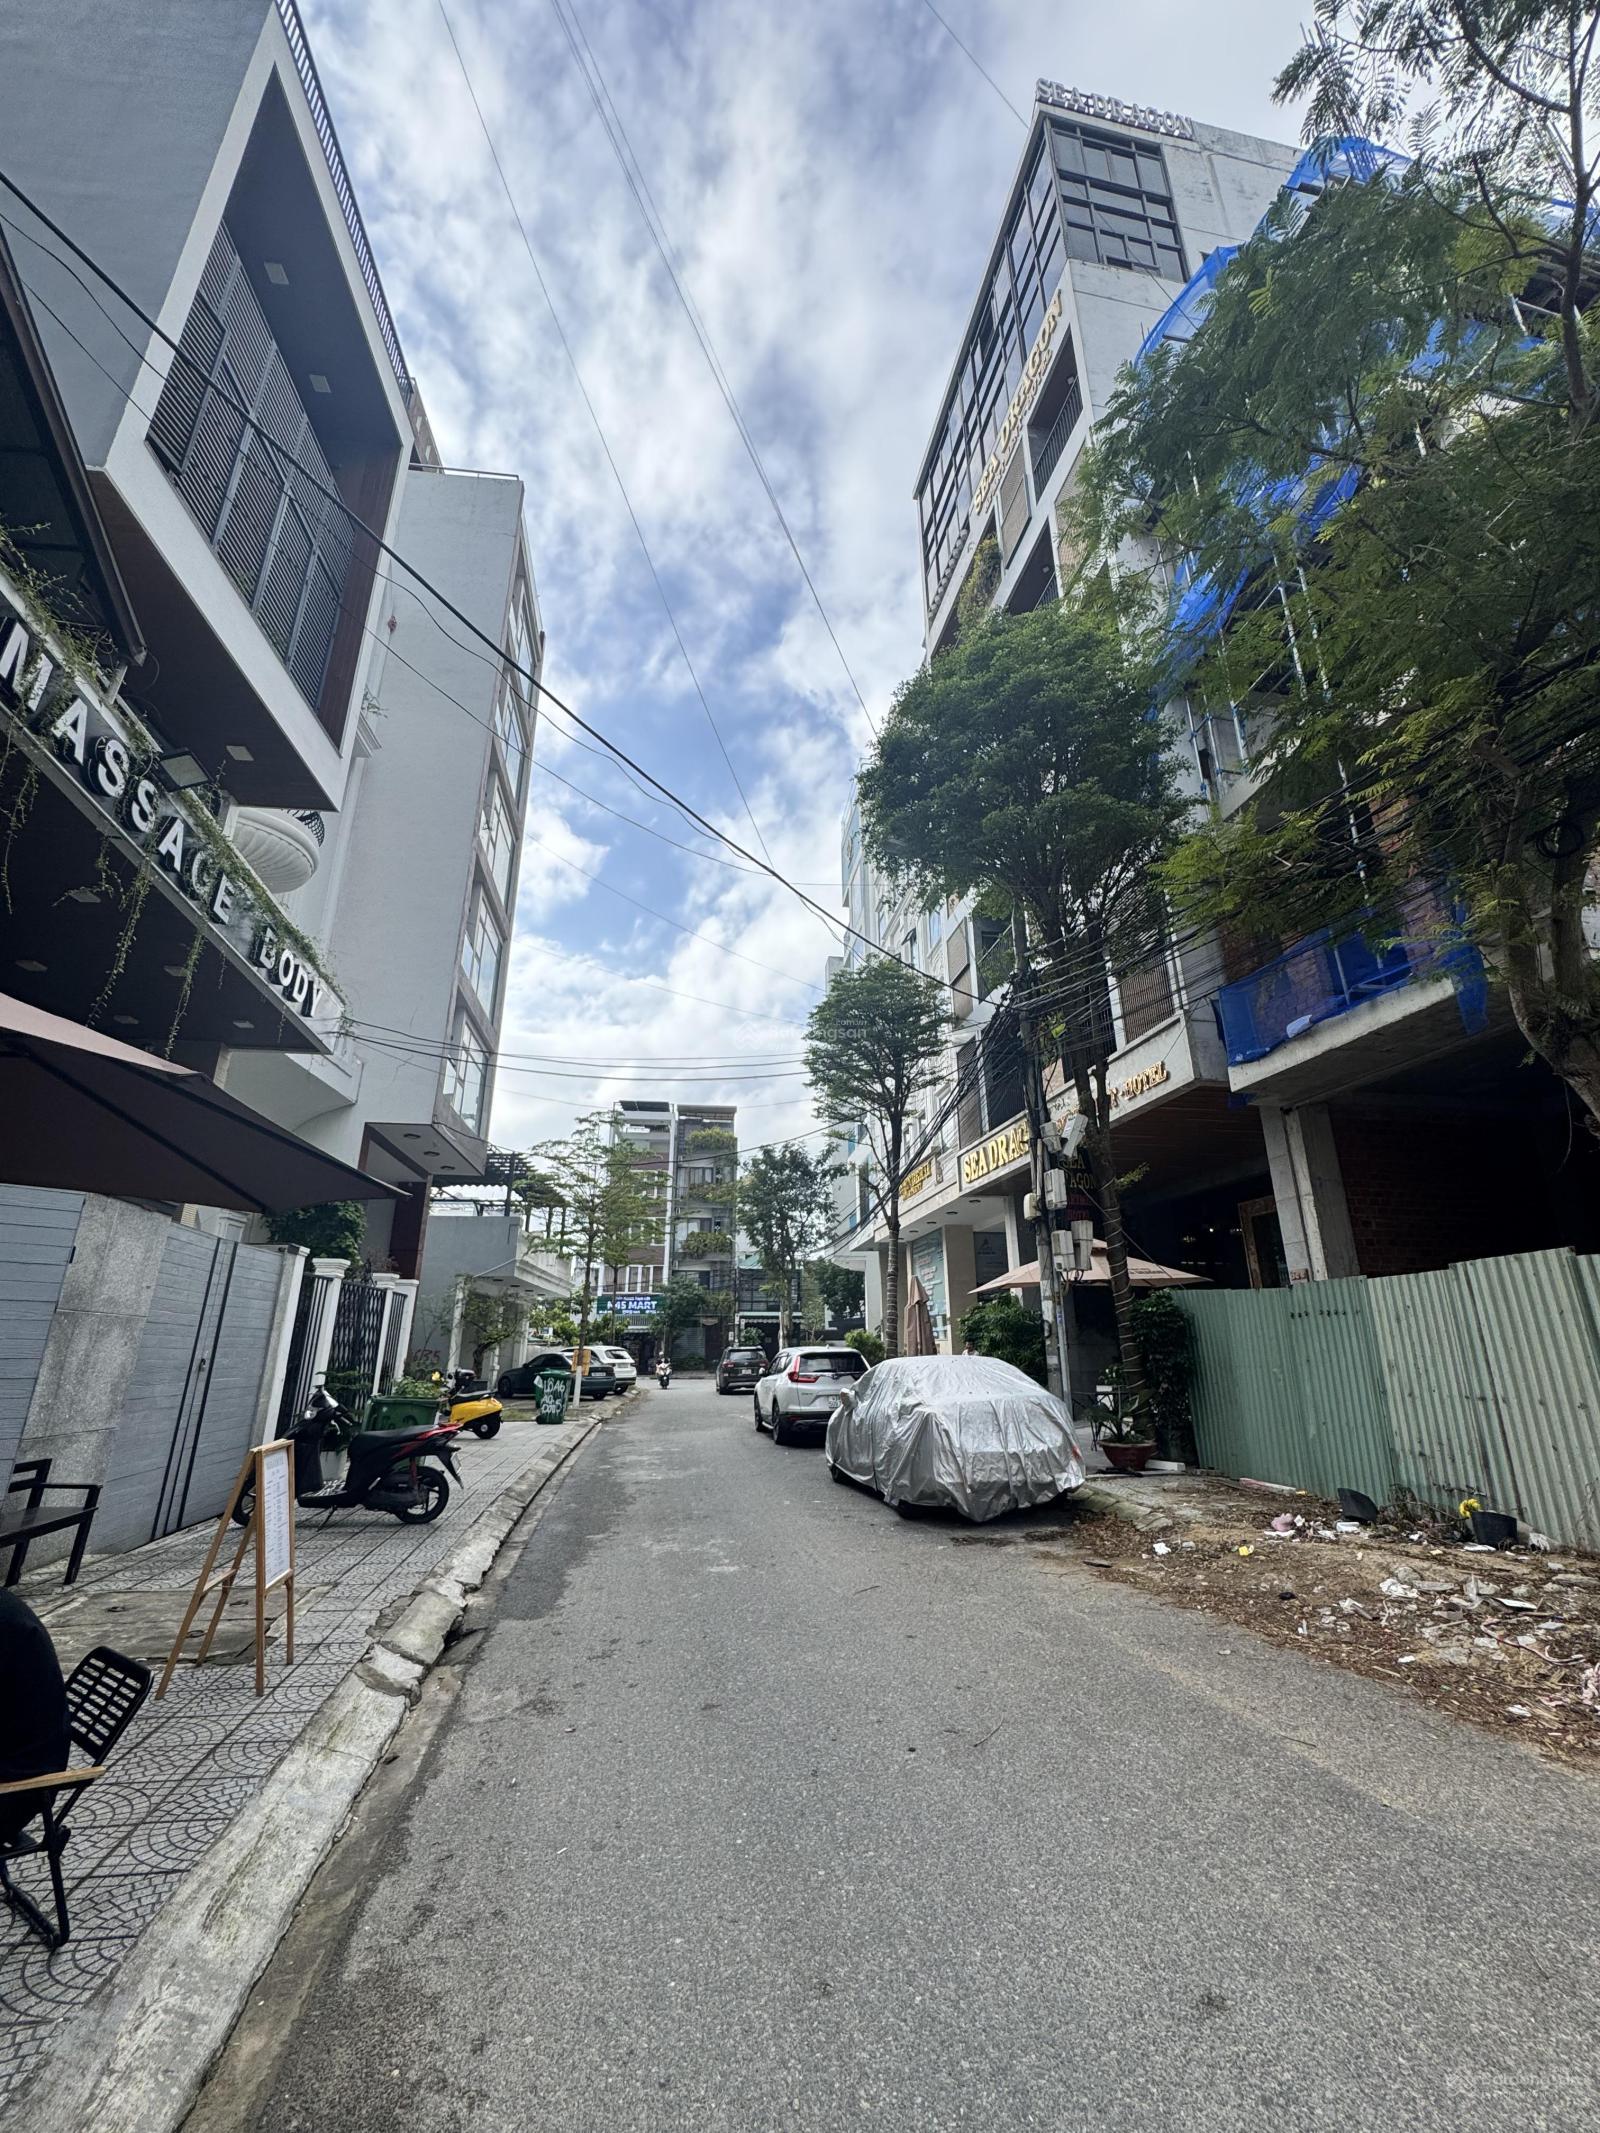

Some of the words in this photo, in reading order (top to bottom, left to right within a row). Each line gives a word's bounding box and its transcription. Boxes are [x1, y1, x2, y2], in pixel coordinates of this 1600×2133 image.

[1036, 77, 1087, 108] SEA
[1091, 92, 1194, 139] DRAGON
[973, 455, 1001, 515] SEA
[999, 289, 1063, 454] DRAGON
[259, 927, 323, 1017] BODY
[1123, 1060, 1168, 1100] HOTEL
[963, 1147, 988, 1184] SEA
[988, 1118, 1030, 1171] DRAG
[628, 1301, 658, 1310] MART
